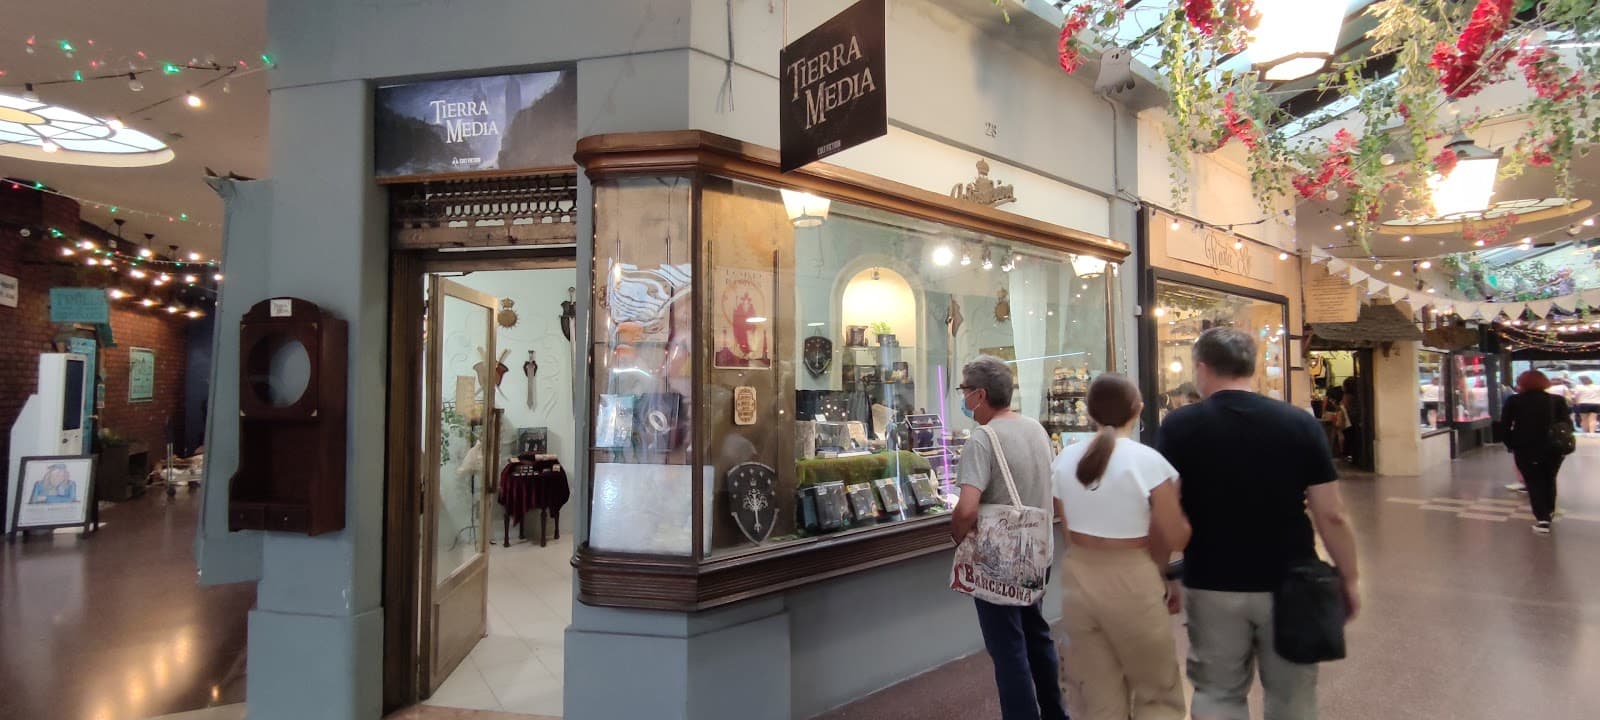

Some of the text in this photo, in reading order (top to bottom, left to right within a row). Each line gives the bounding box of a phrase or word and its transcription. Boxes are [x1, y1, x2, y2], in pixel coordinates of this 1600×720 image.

[787, 35, 863, 103] TIERRA
[430, 99, 489, 124] TIERRA
[804, 66, 877, 130] MEDIA
[446, 119, 498, 143] MEDIA
